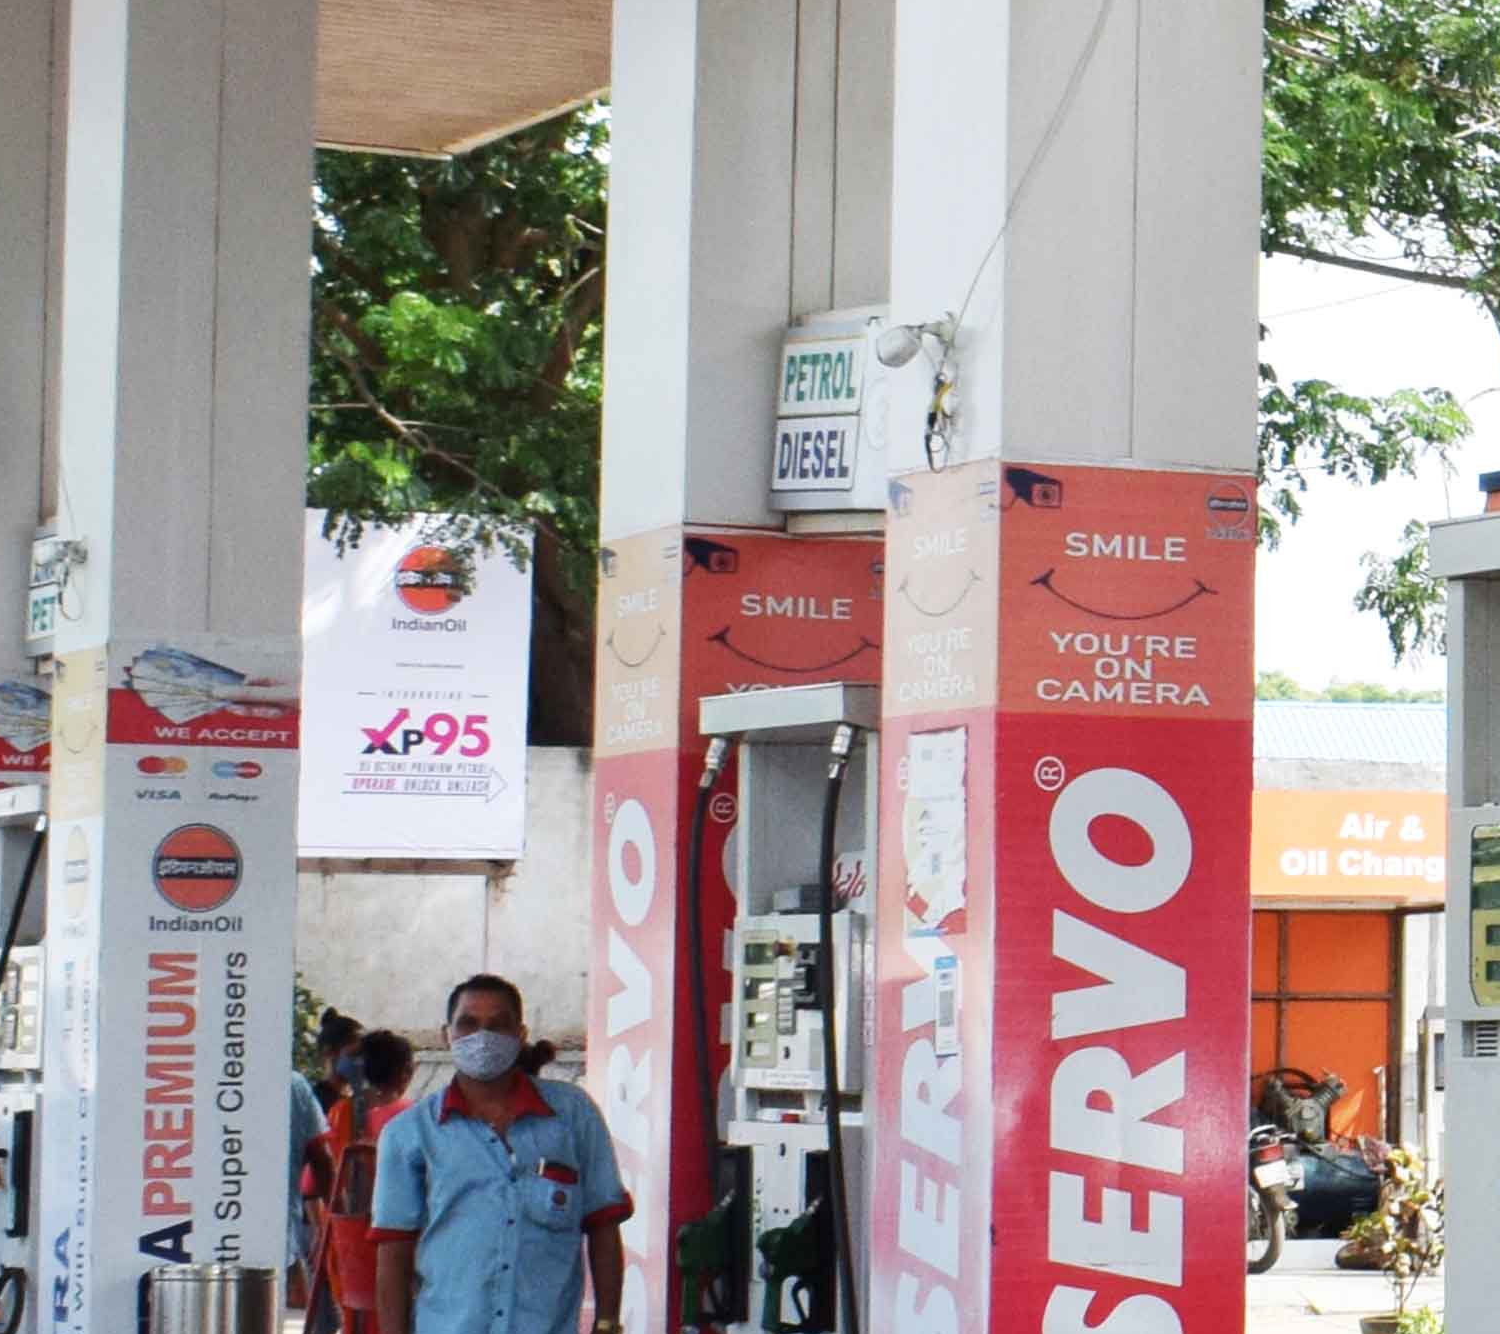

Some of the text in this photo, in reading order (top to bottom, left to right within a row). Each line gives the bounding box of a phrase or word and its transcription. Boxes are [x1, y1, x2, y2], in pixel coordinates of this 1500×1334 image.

[782, 351, 858, 404] PETROL
[776, 427, 850, 480] DIESEL
[911, 528, 967, 561] SMILE
[1064, 531, 1187, 562] SMILE
[618, 588, 661, 619] SMILE
[739, 594, 853, 621] SMILE
[391, 617, 467, 633] IndianOil
[1050, 631, 1197, 660] YOU'RE
[923, 652, 951, 677] ON
[1093, 655, 1153, 681] ON
[899, 674, 976, 703] CAMERA
[1035, 678, 1211, 708] CAMERA
[155, 727, 292, 742] WE ACCEPT
[360, 707, 491, 758] XP95
[606, 714, 664, 744] CAMERA
[1, 753, 36, 767] WE
[1338, 813, 1425, 840] Air &
[1280, 850, 1446, 881] Oil Chang
[148, 915, 244, 933] IndianOil
[217, 950, 249, 1113] Cleansers
[215, 1129, 250, 1223] Super
